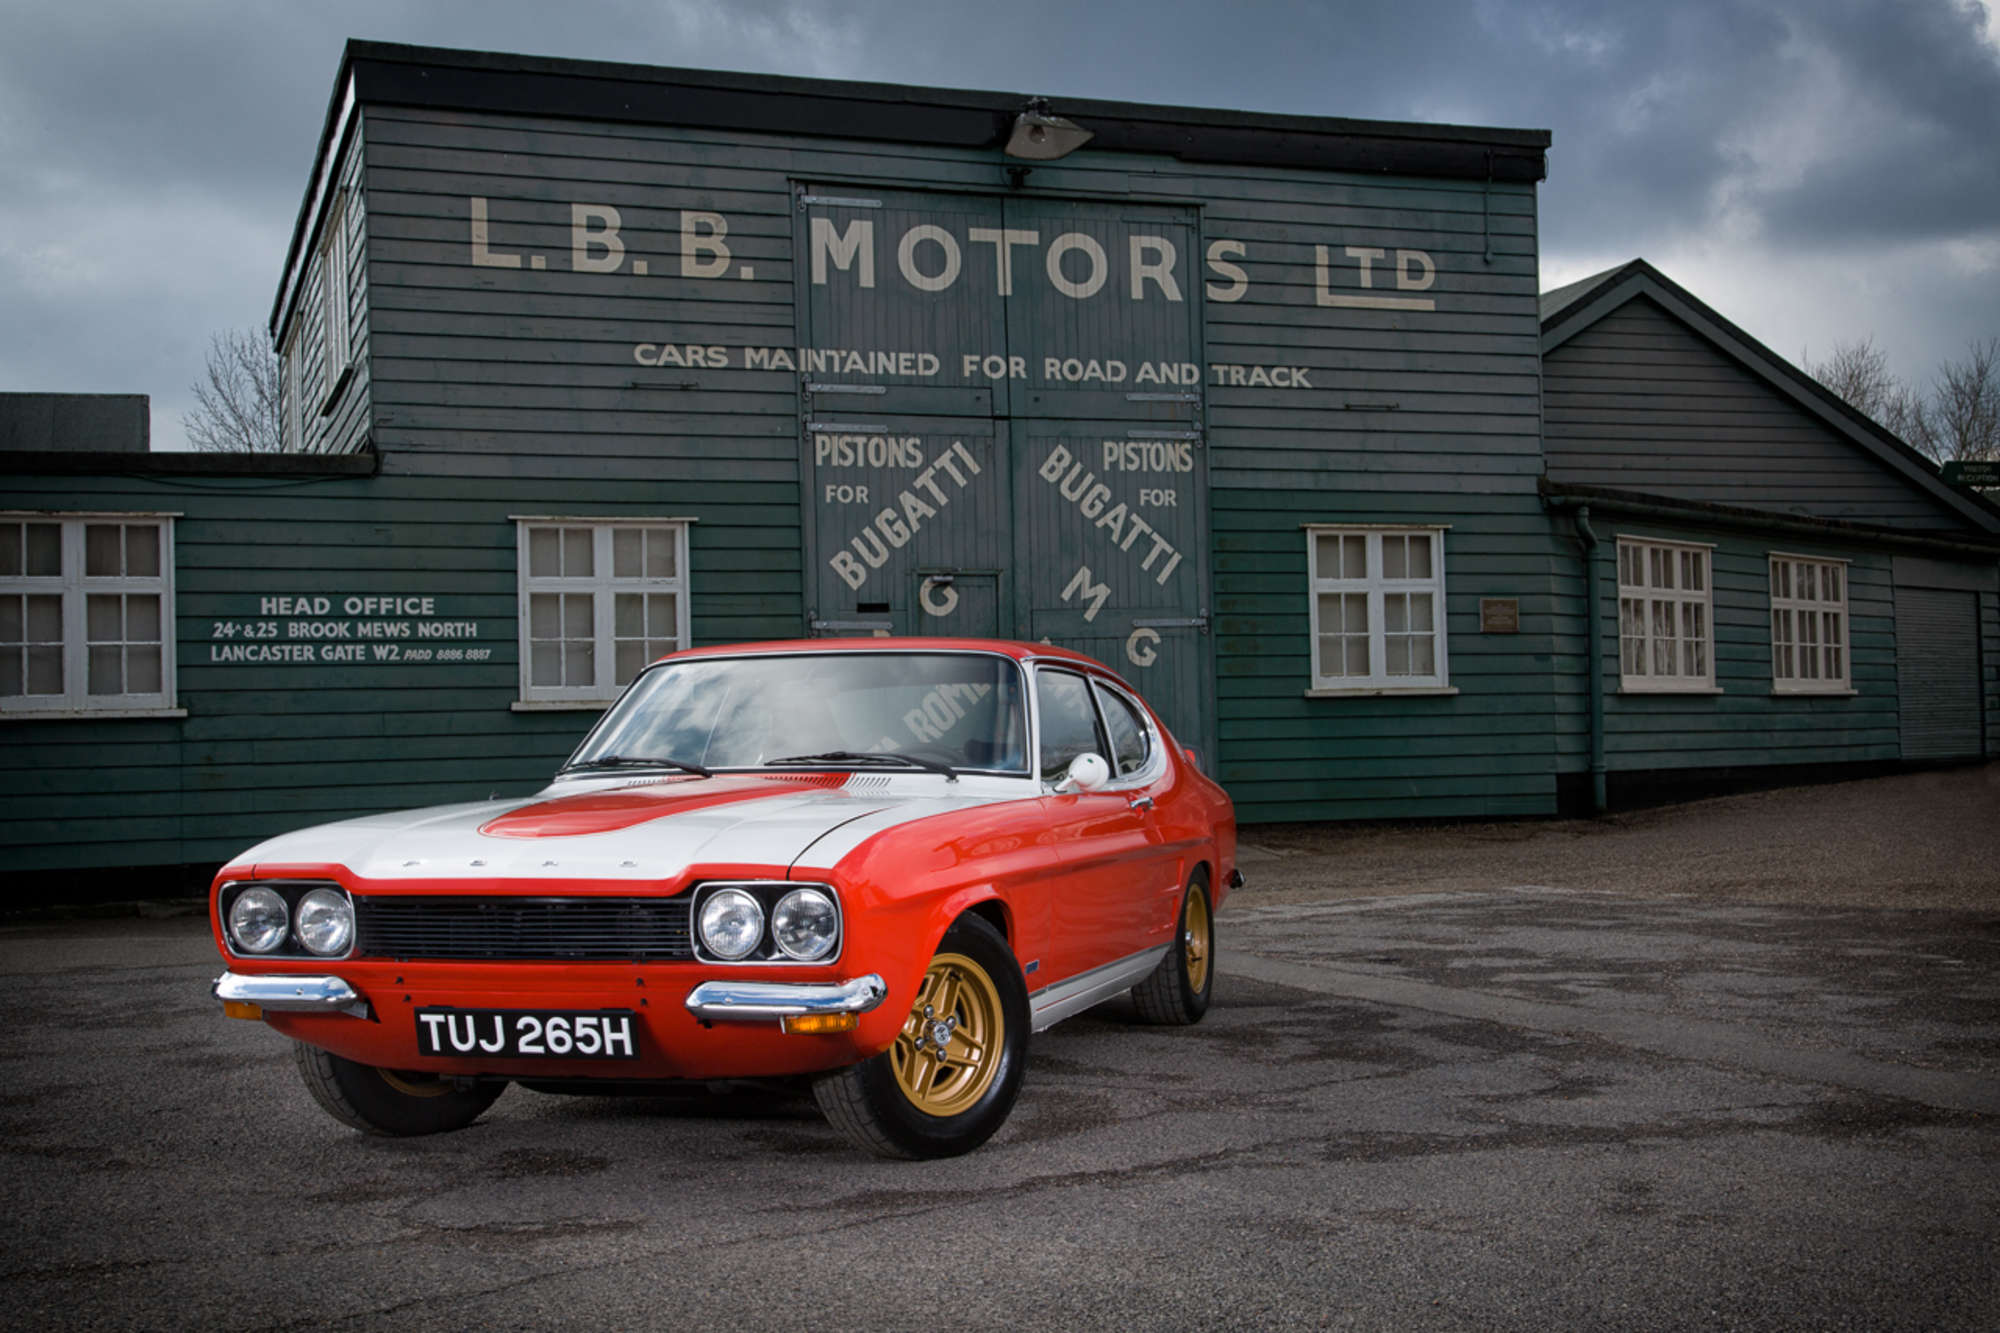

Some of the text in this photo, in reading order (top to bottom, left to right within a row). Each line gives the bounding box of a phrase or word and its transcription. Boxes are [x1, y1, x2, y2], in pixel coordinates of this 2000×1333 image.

[810, 217, 1249, 302] MOTORS
[1315, 245, 1436, 311] LTD
[633, 344, 1313, 388] CARS MAINTAINED FOR ROAD AND TRACK
[815, 434, 924, 469] PISTONS
[1103, 441, 1193, 473] PISTONS
[825, 484, 869, 504] FOR
[1139, 488, 1177, 507] FOR
[829, 440, 982, 591] BUGATTI
[1038, 444, 1183, 586] BUGATTI
[261, 596, 435, 615] HEAD OFFICE
[919, 575, 959, 617] G
[288, 621, 351, 638] BROOK
[357, 622, 411, 638] MEWS
[417, 622, 478, 638] NORTH
[1060, 565, 1162, 667] M G
[211, 644, 316, 662] LANCASTER
[320, 644, 366, 661] GATE
[372, 644, 401, 661] W2
[419, 1013, 633, 1056] TUJ 265H
